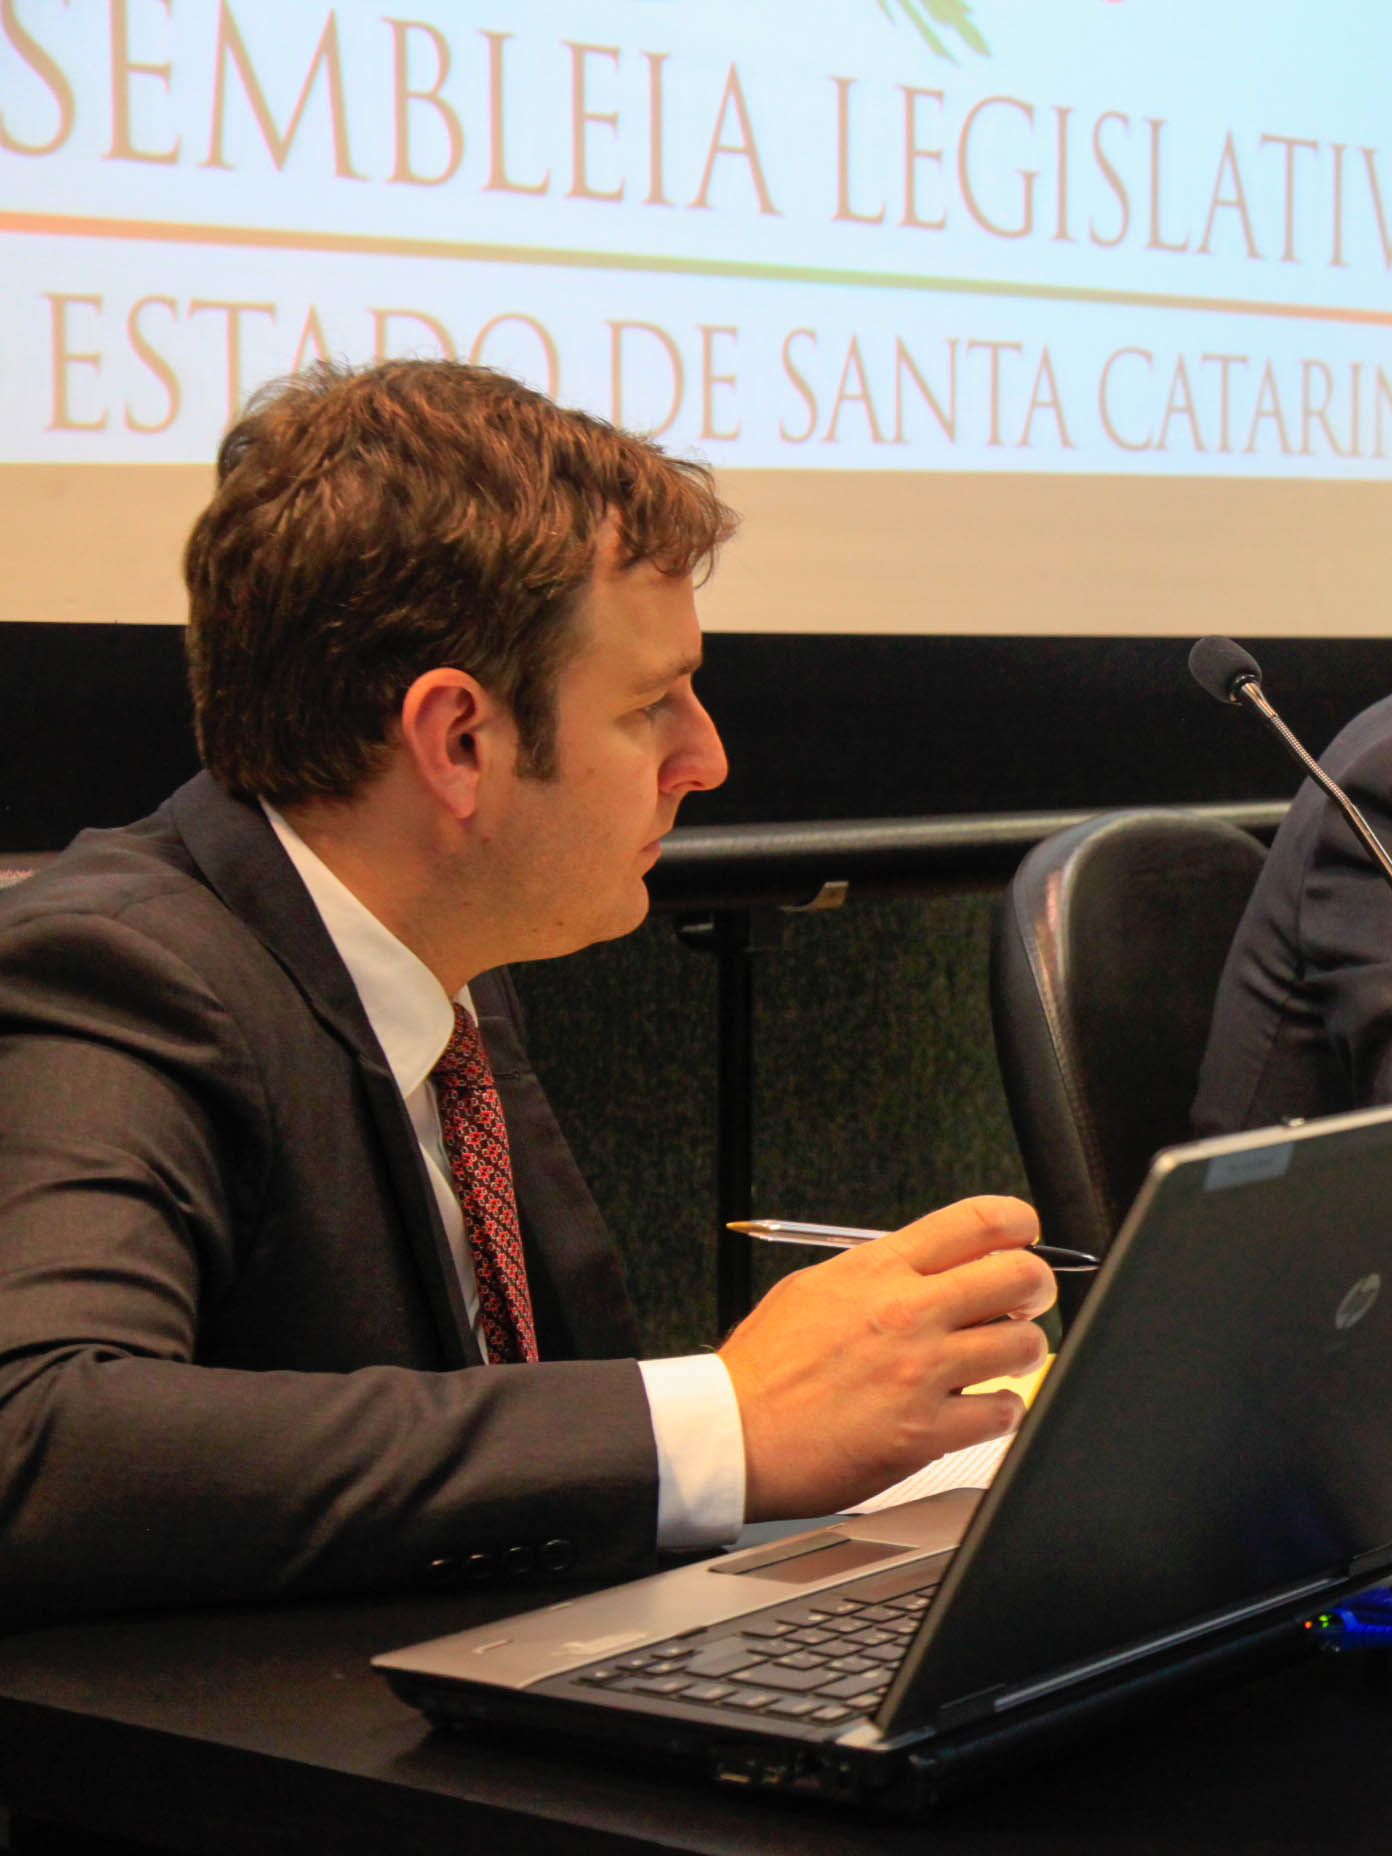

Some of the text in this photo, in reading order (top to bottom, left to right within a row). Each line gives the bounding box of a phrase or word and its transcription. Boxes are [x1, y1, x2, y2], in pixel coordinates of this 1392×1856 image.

[0, 0, 783, 216] SEMBLEIA
[606, 319, 742, 443] DE
[779, 326, 1078, 450] SANTA
